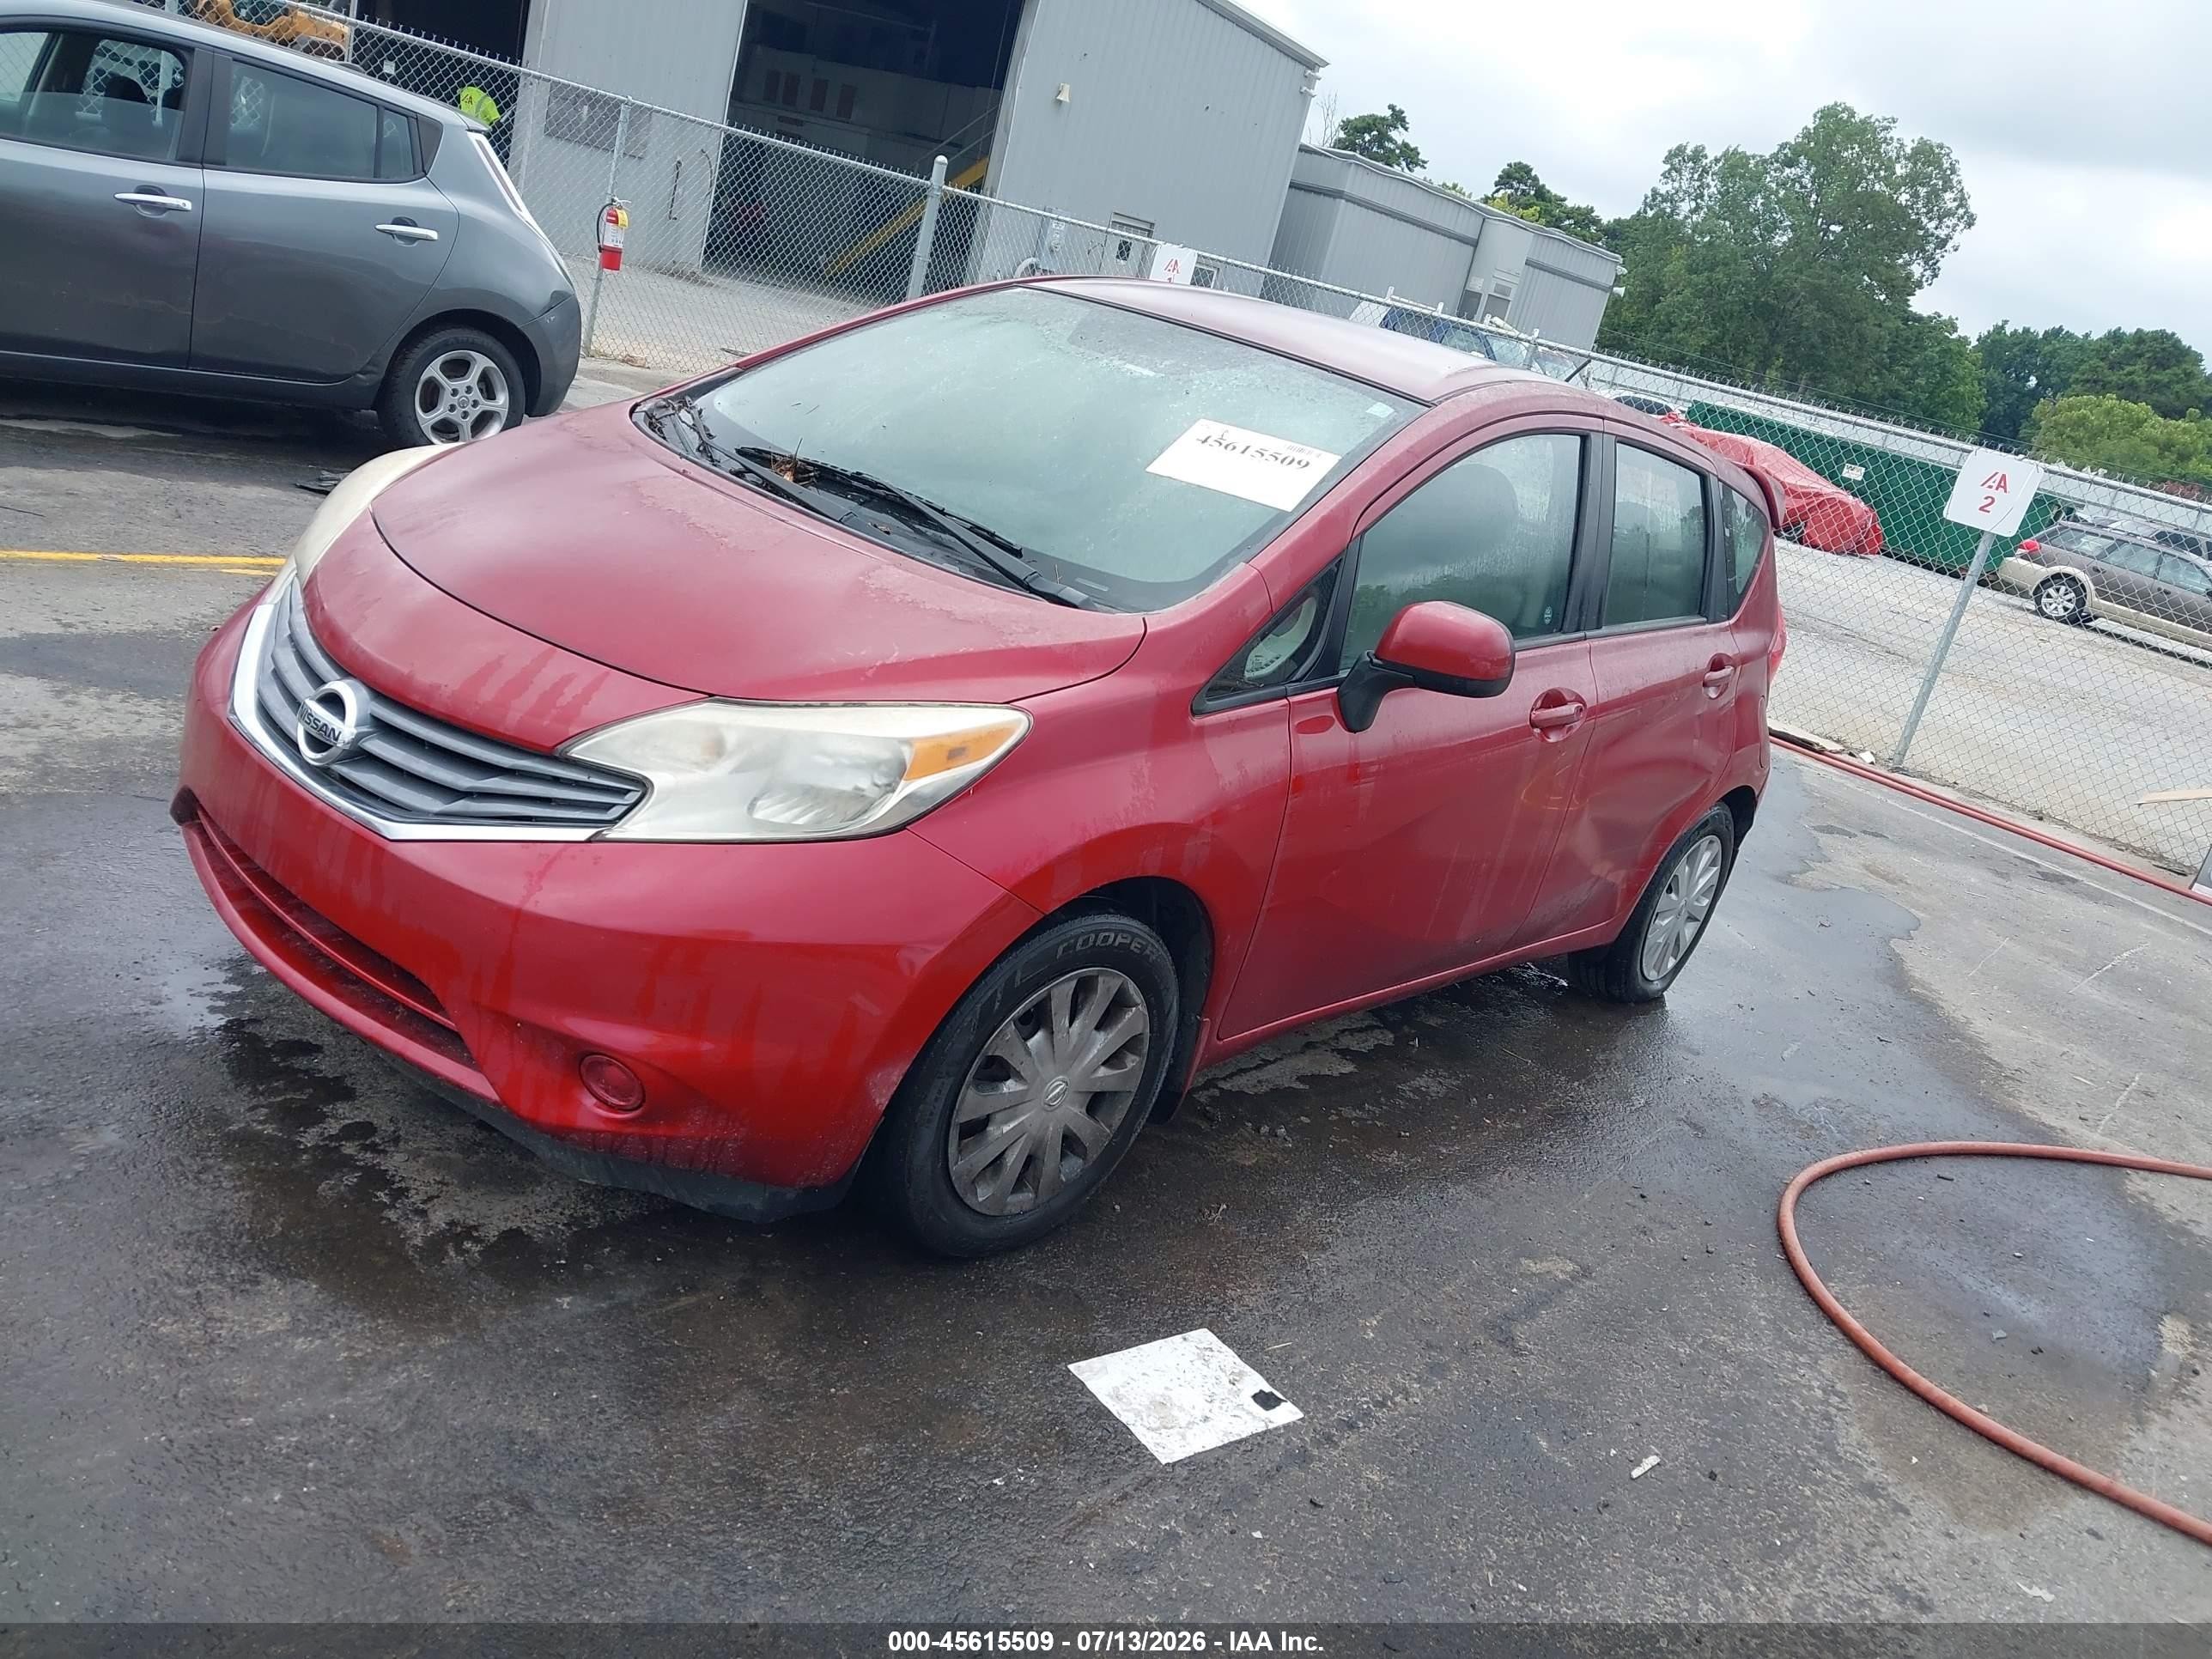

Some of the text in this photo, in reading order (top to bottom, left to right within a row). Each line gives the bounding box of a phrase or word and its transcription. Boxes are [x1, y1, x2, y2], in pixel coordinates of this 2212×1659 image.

[1195, 434, 1310, 471] 45615509
[1978, 495, 1996, 514] 2
[300, 704, 342, 743] NISSAN
[1055, 932, 1159, 963] COOPER
